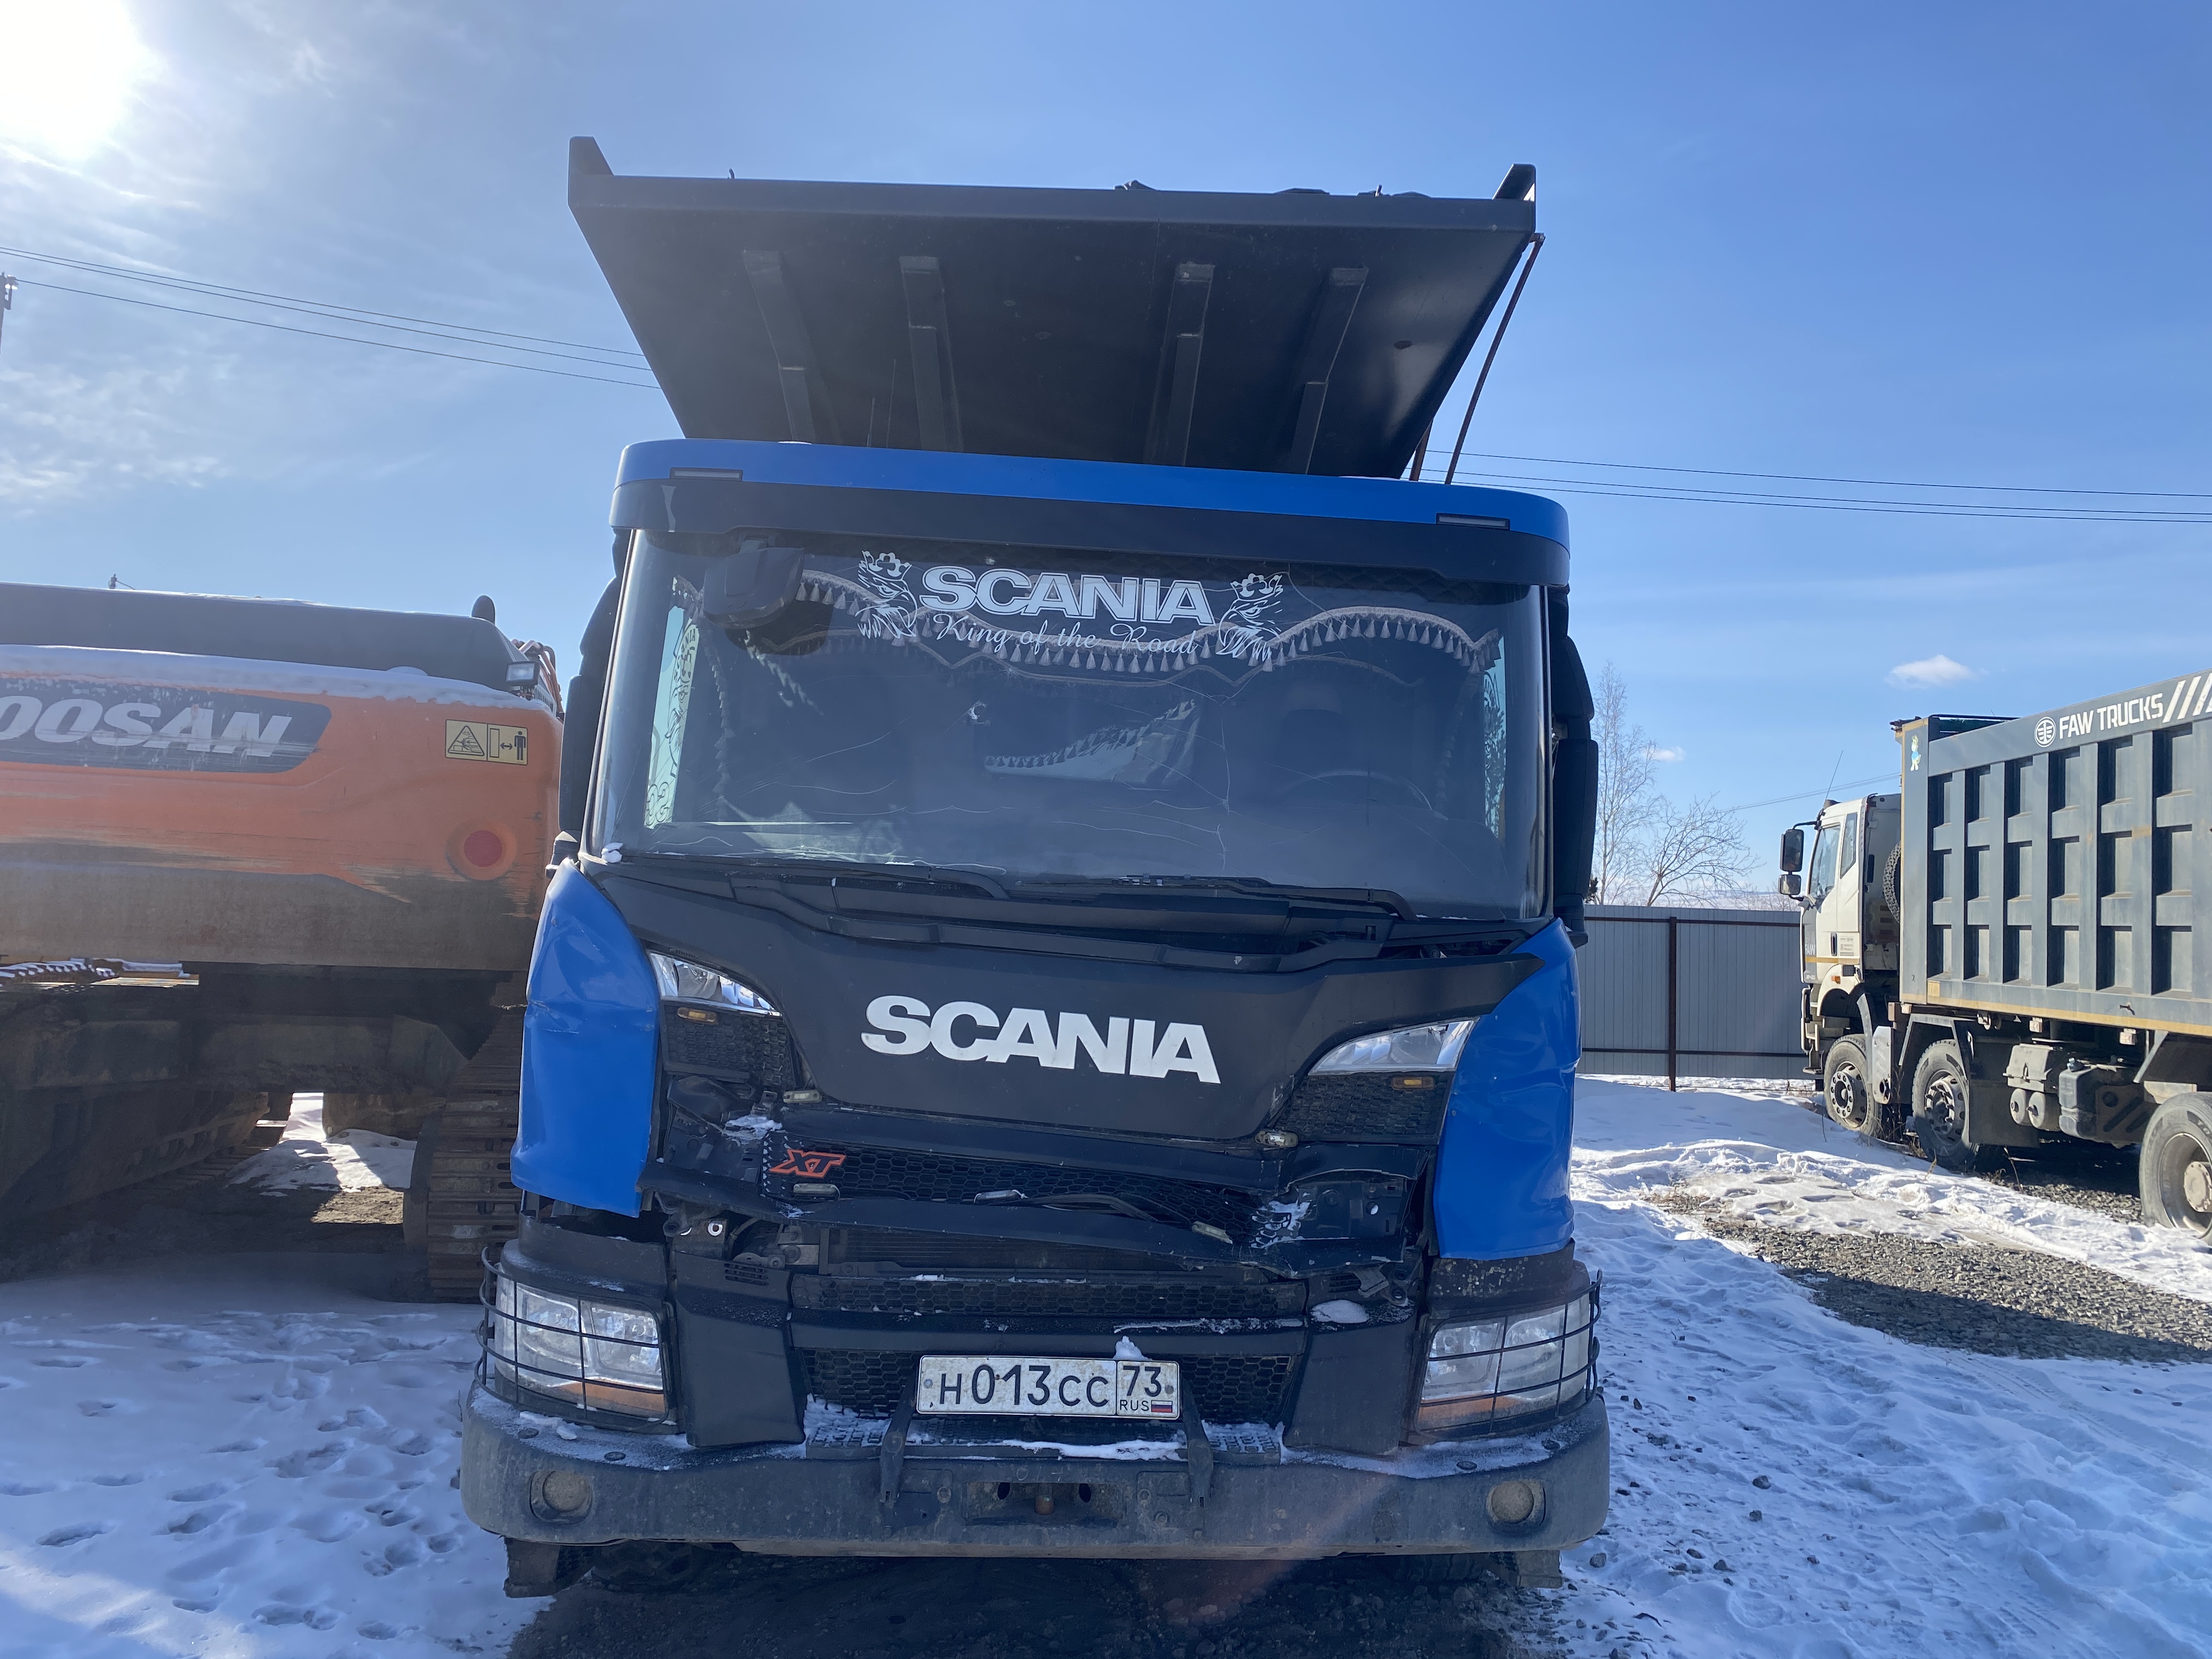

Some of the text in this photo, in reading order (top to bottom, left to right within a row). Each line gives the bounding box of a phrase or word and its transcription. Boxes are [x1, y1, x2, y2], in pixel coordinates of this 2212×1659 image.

[919, 566, 1216, 625] SCANIA
[933, 613, 1206, 655] King of the Road
[2059, 693, 2163, 739] FAW TRUCKS
[860, 995, 1221, 1085] SCANIA
[769, 1149, 846, 1178] XT
[1122, 1365, 1162, 1397] 73
[1119, 1399, 1149, 1412] RUS
